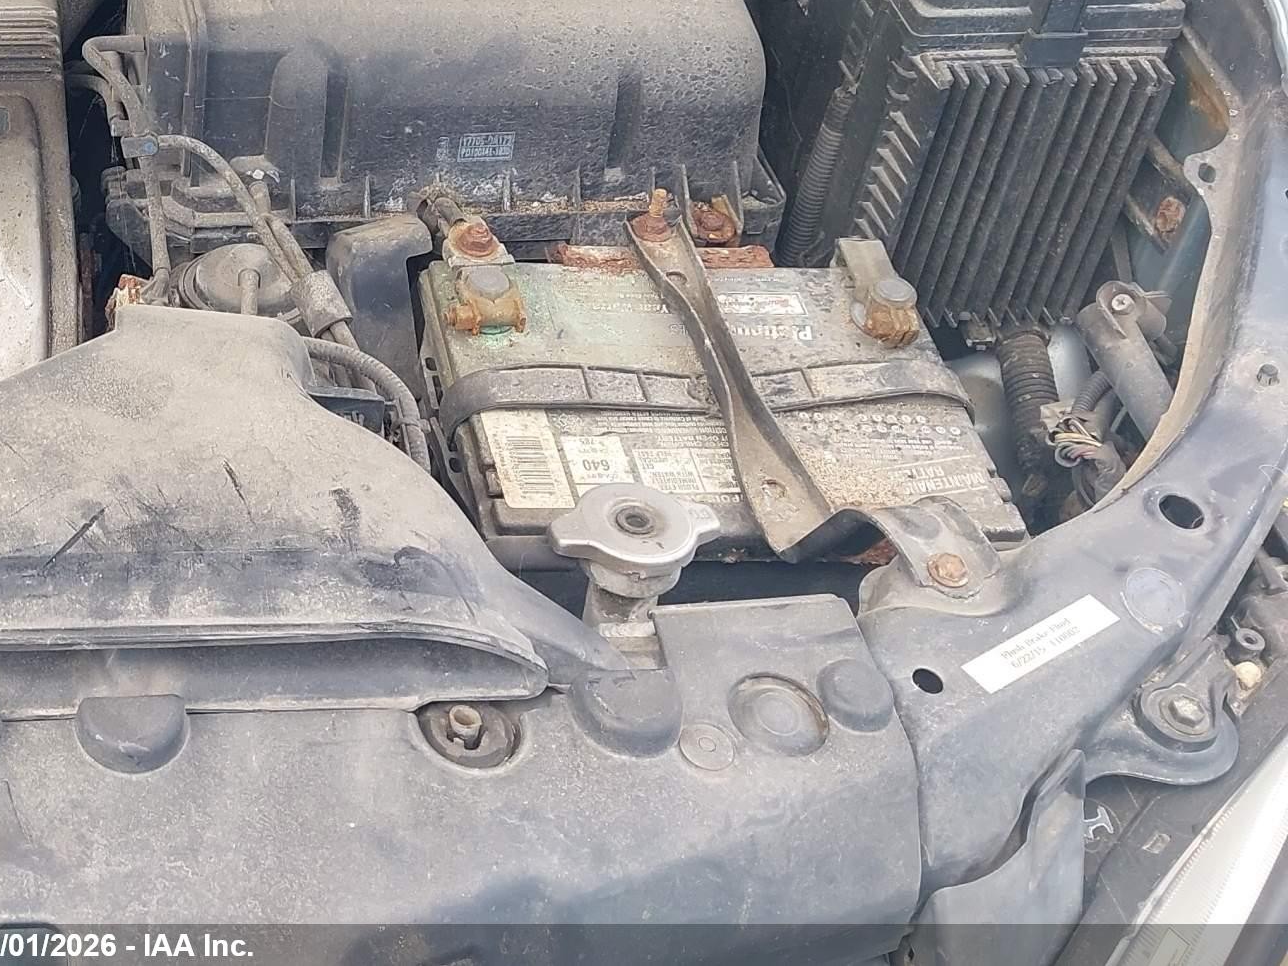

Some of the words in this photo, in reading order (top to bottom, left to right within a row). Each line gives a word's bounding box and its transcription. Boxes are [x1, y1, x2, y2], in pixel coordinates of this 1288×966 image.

[729, 324, 812, 341] Platinu
[581, 458, 610, 472] 640
[906, 472, 985, 495] MAINTENANC
